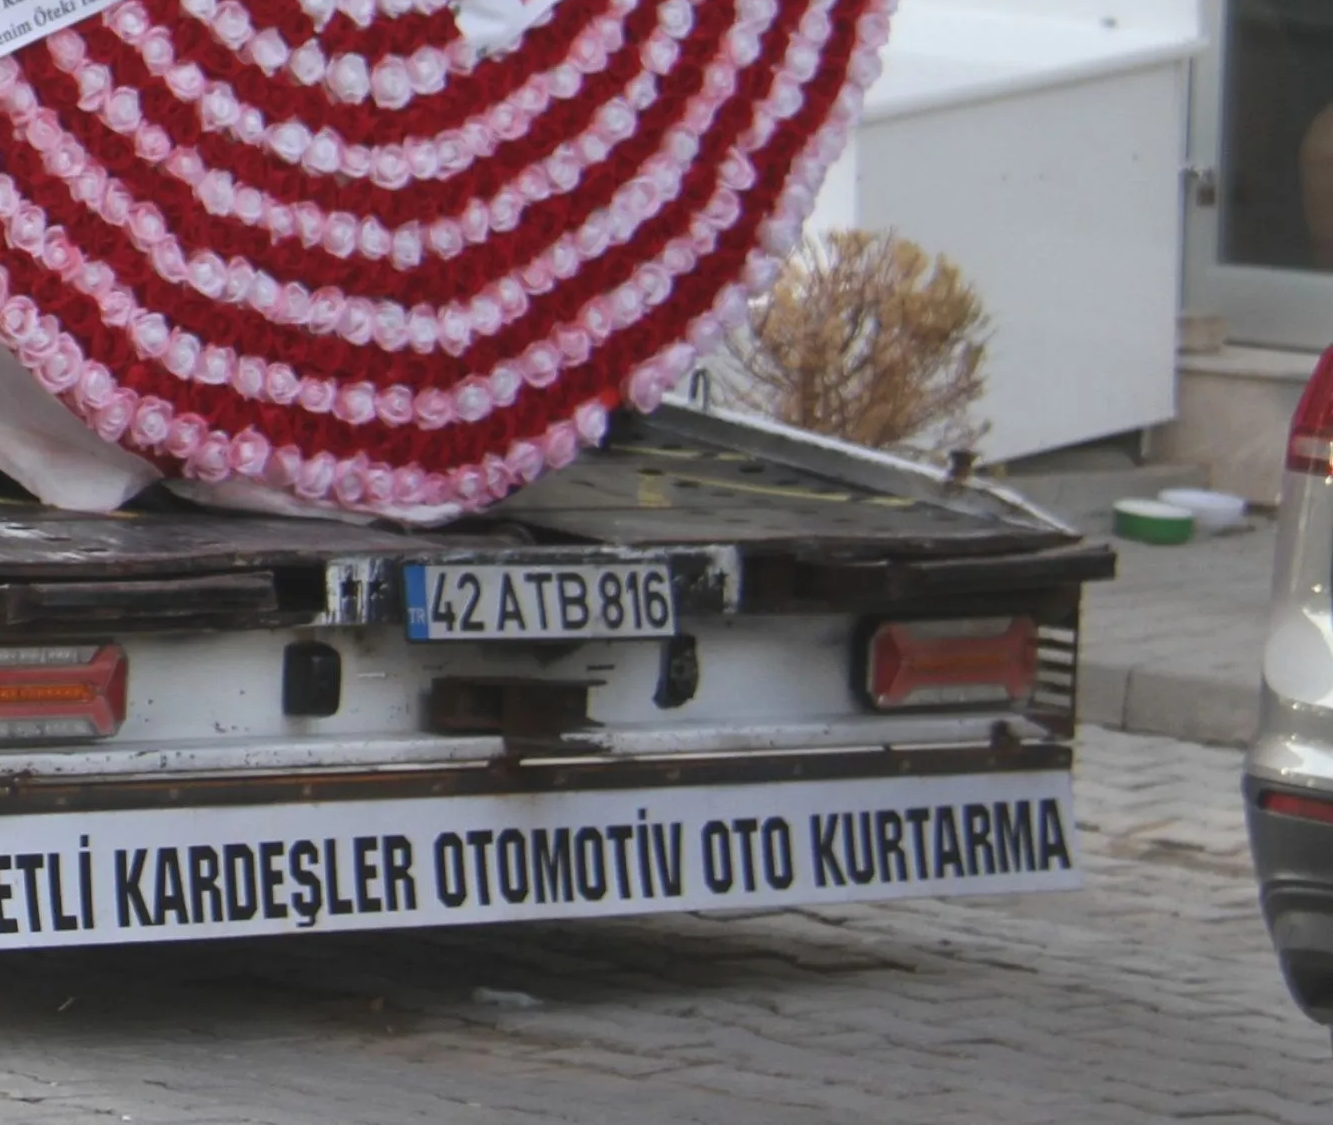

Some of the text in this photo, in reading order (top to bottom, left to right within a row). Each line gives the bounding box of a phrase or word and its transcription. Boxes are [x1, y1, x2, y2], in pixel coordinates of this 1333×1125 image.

[432, 570, 670, 632] 42 ATB 816
[114, 833, 418, 928] KARDEŞLER
[433, 808, 683, 909] OTOMOTİV
[700, 816, 794, 895] OTO
[809, 796, 1073, 888] KURTARMA
